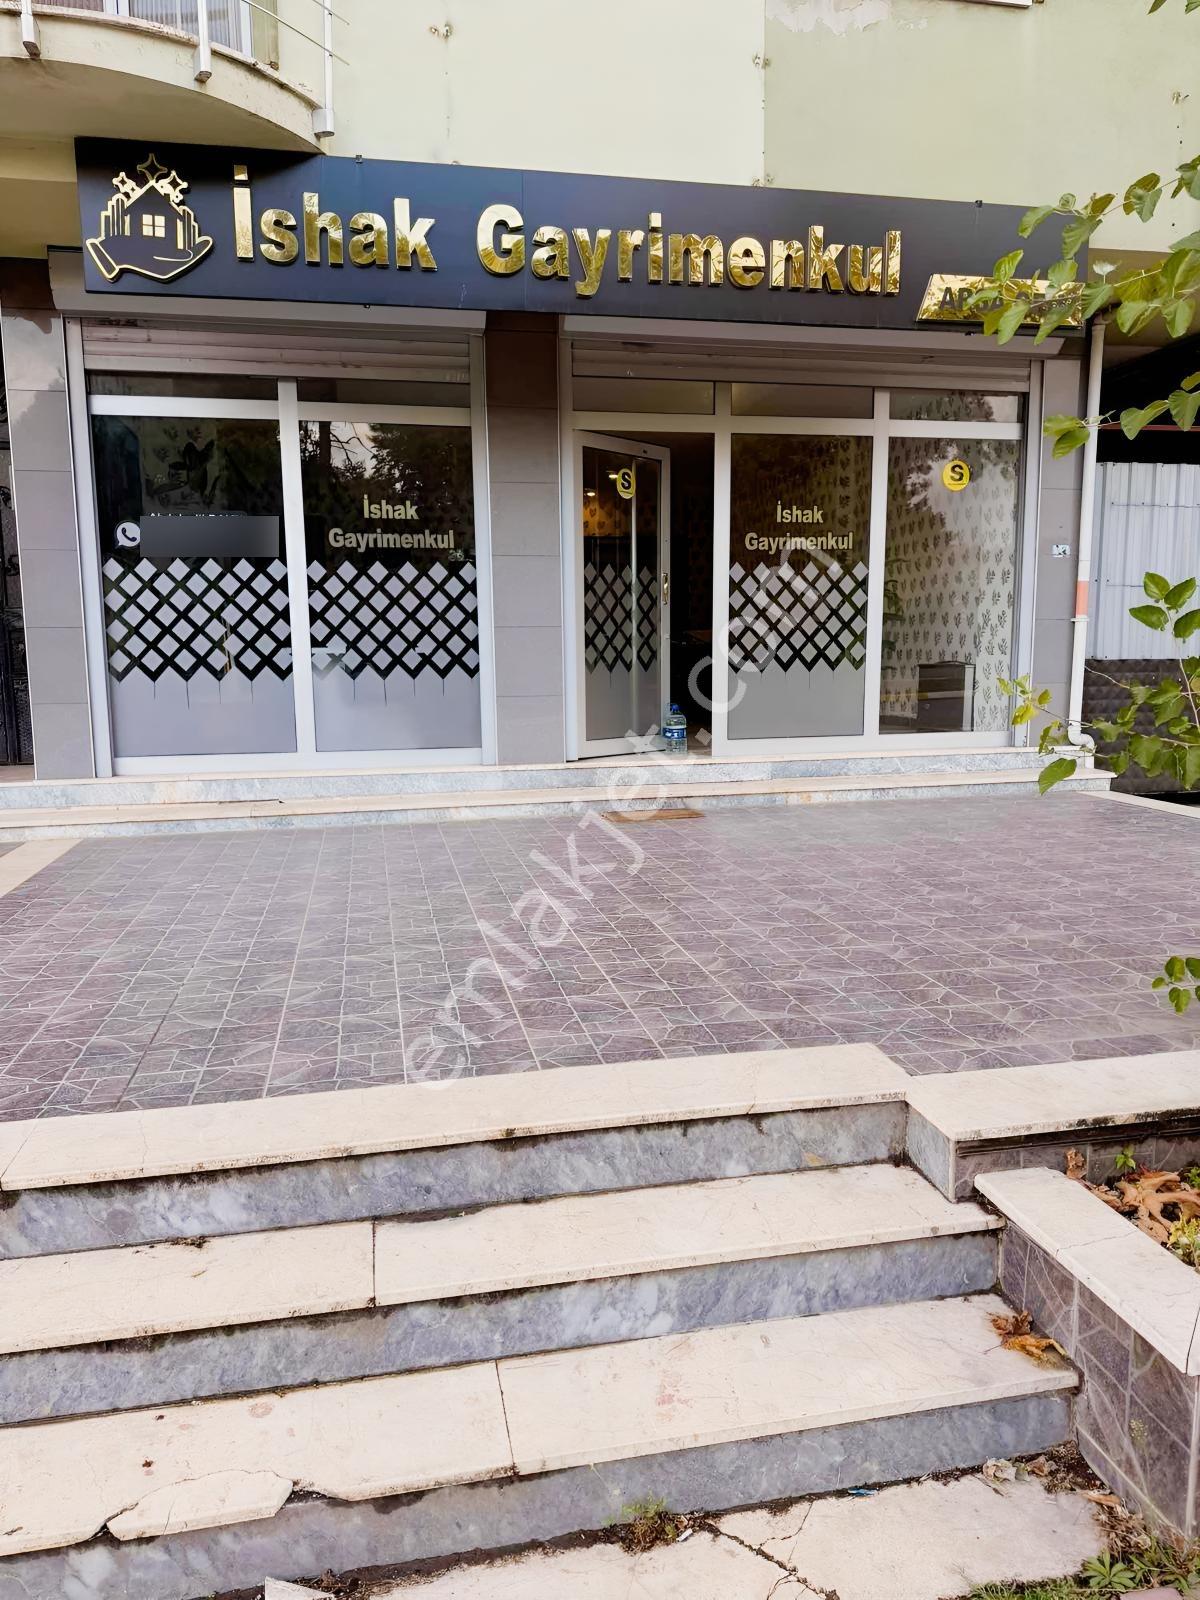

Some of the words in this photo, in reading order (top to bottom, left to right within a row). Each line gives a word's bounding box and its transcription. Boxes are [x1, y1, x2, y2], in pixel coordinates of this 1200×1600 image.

[233, 164, 437, 271] İshak
[476, 203, 902, 298] Gayrimenkul
[363, 494, 419, 519] İshak
[776, 500, 824, 523] İshak
[328, 527, 455, 553] Gayrimenkul
[744, 532, 853, 554] Gayrimenkul
